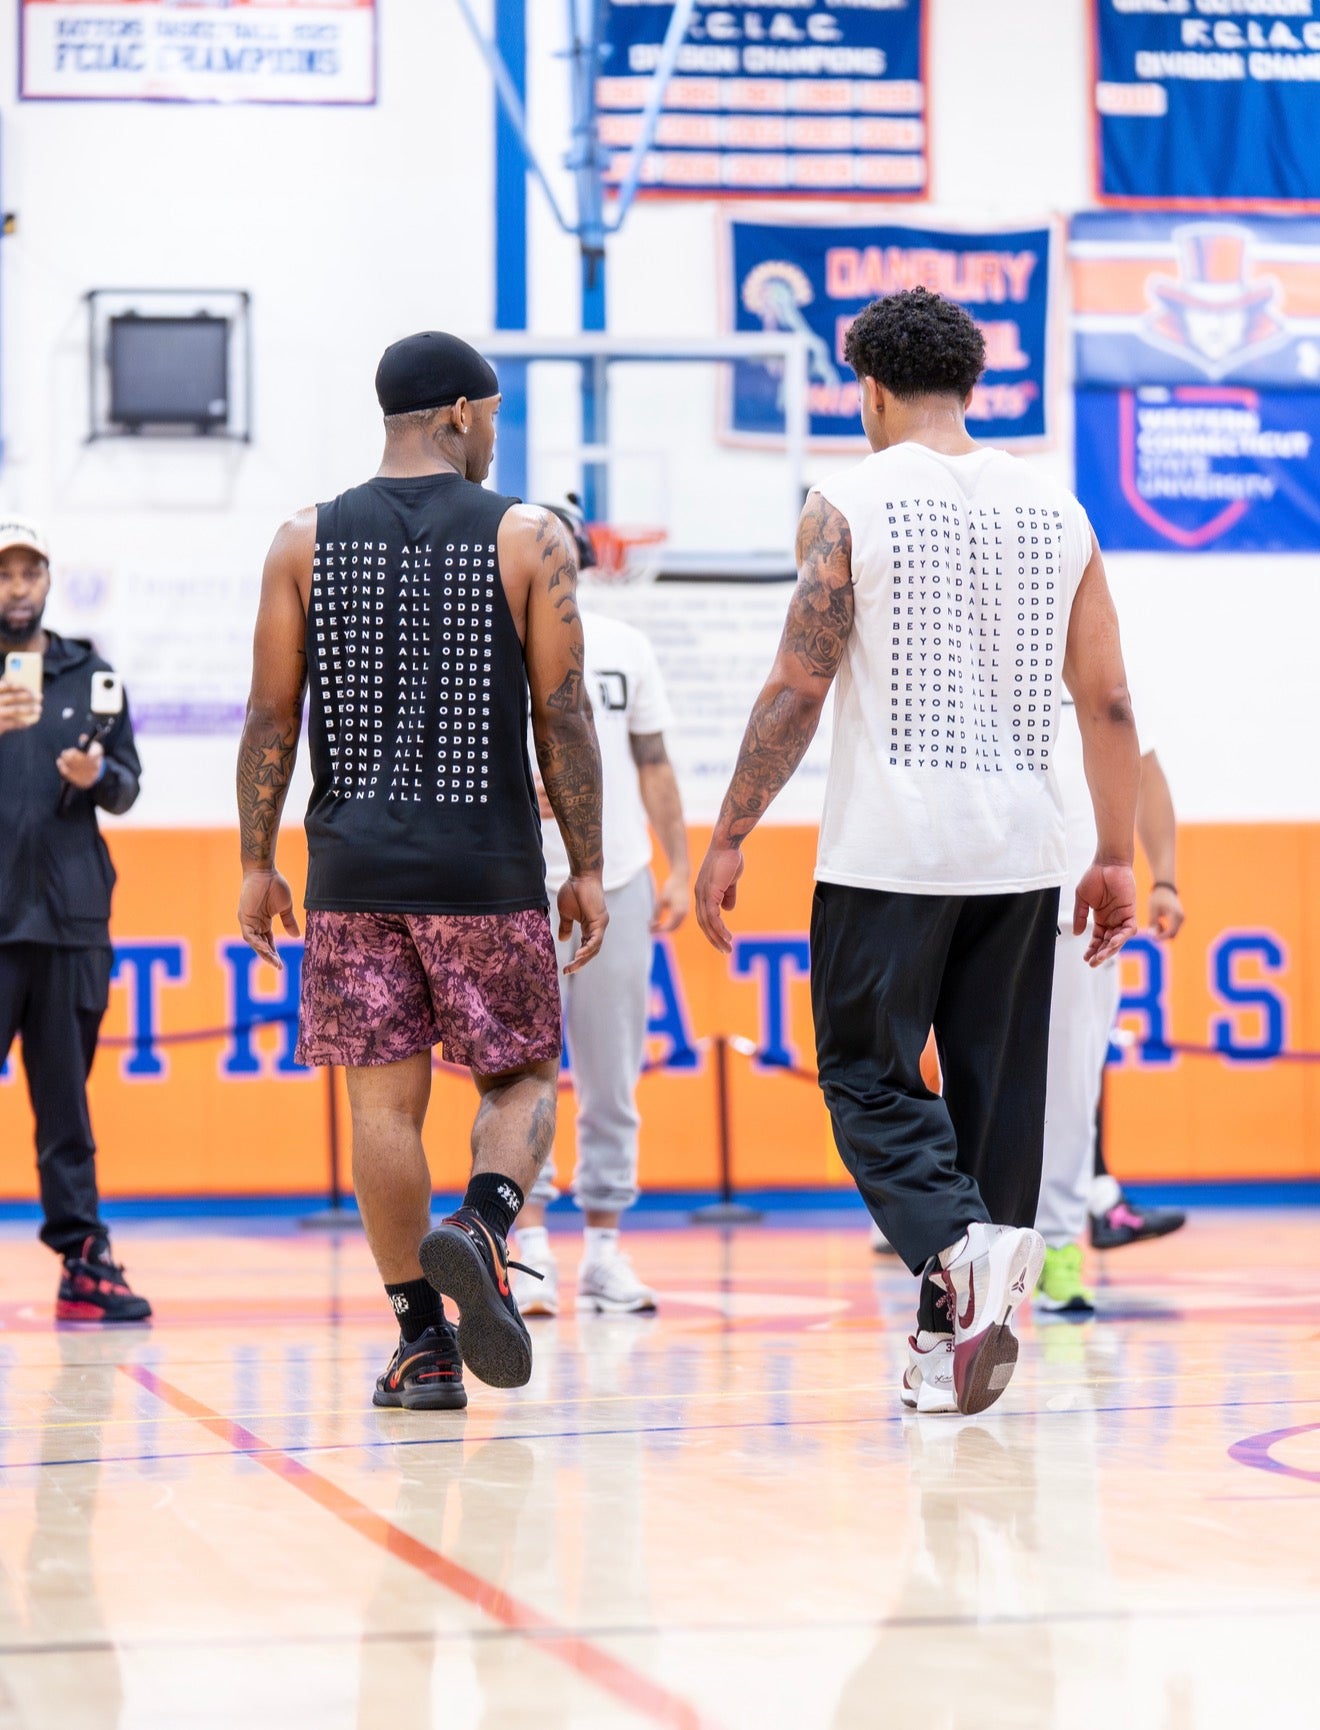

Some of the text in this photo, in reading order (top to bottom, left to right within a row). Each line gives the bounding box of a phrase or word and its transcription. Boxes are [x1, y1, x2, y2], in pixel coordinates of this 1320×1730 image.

[825, 246, 1037, 303] DANBURY
[885, 498, 958, 512] BEYOND
[887, 512, 960, 527] BEYOND
[968, 521, 1002, 531] ALL
[890, 527, 961, 542] BEYOND
[968, 536, 1003, 546] ALL
[401, 543, 432, 555] ALL
[445, 543, 496, 553] ODDS
[892, 543, 961, 557] BEYOND
[969, 551, 1003, 561] ALL
[311, 554, 495, 569] BEYOND ALL ODDS
[893, 559, 962, 572] BEYOND
[968, 566, 1003, 576] ALL
[312, 569, 494, 583] BEYOND ALL ODDS
[892, 574, 963, 587] BEYOND
[968, 581, 1003, 591] ALL
[313, 584, 494, 598] BEYOND ALL ODDS
[892, 590, 963, 603] BEYOND
[968, 596, 1002, 607] ALL
[398, 602, 431, 612] ALL
[443, 601, 493, 613] ODDS
[892, 606, 962, 618] BEYOND
[967, 611, 1002, 622] ALL
[315, 614, 493, 628] BEYOND ALL ODDS
[316, 629, 492, 643] BEYOND ALL ODDS
[892, 621, 962, 634] BEYOND
[968, 627, 1001, 637] ALL
[891, 636, 962, 649] BEYOND
[398, 647, 431, 657] ALL
[441, 646, 492, 658] ODDS
[891, 652, 963, 664] BEYOND
[398, 661, 429, 671] ALL
[441, 661, 492, 673] ODDS
[891, 667, 963, 680] BEYOND
[398, 676, 428, 686] ALL
[440, 676, 491, 687] ODDS
[890, 682, 964, 695] BEYOND
[398, 690, 427, 701] ALL
[439, 691, 491, 702] ODDS
[397, 705, 426, 715] ALL
[439, 705, 490, 717] ODDS
[890, 697, 964, 710] BEYOND
[973, 703, 998, 713] ALL
[396, 719, 425, 730] ALL
[438, 720, 490, 731] ODDS
[890, 712, 965, 725] BEYOND
[973, 717, 998, 728] ALL
[395, 734, 424, 744] ALL
[438, 735, 489, 745] ODDS
[890, 727, 966, 740] BEYOND
[974, 732, 999, 743] ALL
[394, 748, 424, 759] ALL
[437, 749, 489, 760] ODDS
[889, 742, 967, 755] BEYOND
[975, 747, 1001, 758] ALL
[392, 762, 423, 773] ALL
[437, 764, 489, 775] ODDS
[889, 756, 967, 770] BEYOND
[975, 762, 1003, 773] ALL
[390, 777, 422, 788] ALL
[436, 778, 489, 789] ODDS
[388, 791, 422, 802] ALL
[435, 793, 488, 804] ODDS
